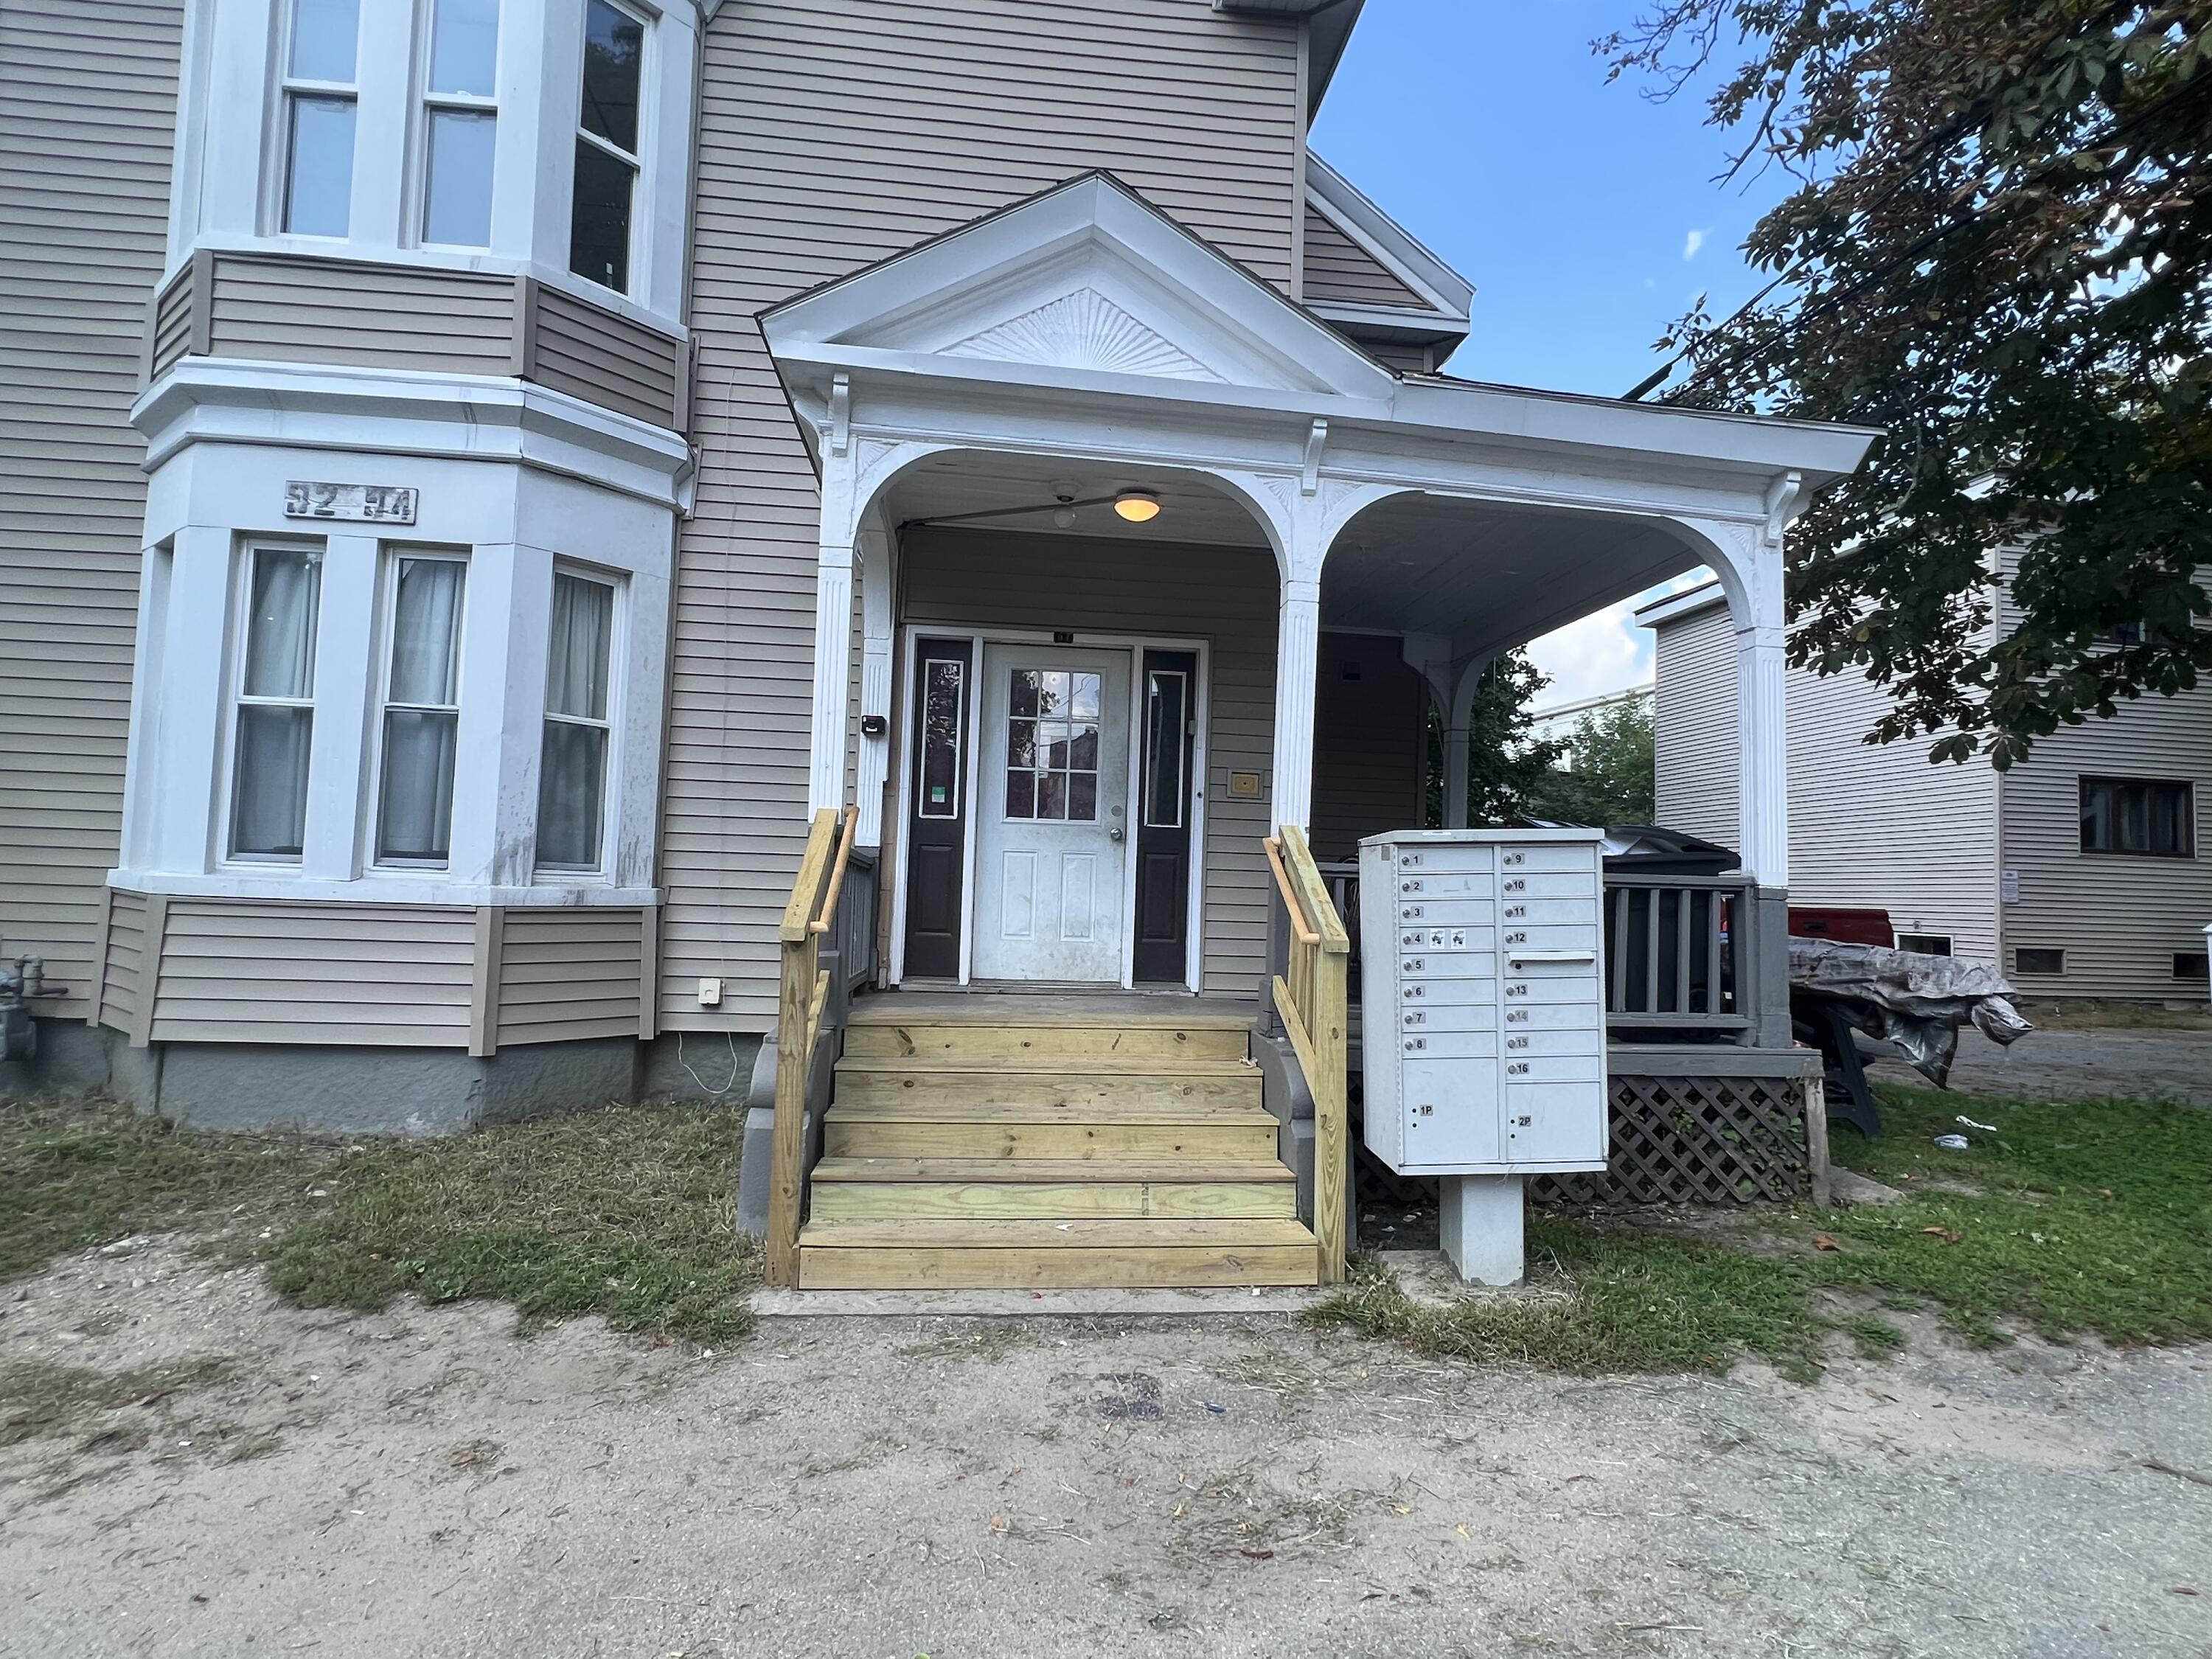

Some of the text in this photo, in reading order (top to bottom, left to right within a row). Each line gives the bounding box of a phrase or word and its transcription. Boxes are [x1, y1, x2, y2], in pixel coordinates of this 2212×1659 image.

[1515, 855, 1522, 863] 9
[1413, 882, 1420, 890] 2
[1513, 880, 1524, 889] 10
[1414, 908, 1420, 917] 3
[1514, 907, 1524, 916] 11
[1414, 934, 1421, 943] 4
[1514, 933, 1526, 942] 12
[1415, 960, 1422, 970] 5
[1416, 987, 1422, 996] 6
[1516, 985, 1526, 995] 13
[1416, 1013, 1422, 1022] 7
[1517, 1012, 1527, 1021] 14
[1416, 1040, 1423, 1049] 8
[1517, 1038, 1528, 1048] 15
[1517, 1063, 1528, 1073] 16
[1421, 1105, 1432, 1115] 1P
[1519, 1116, 1531, 1126] 2P
